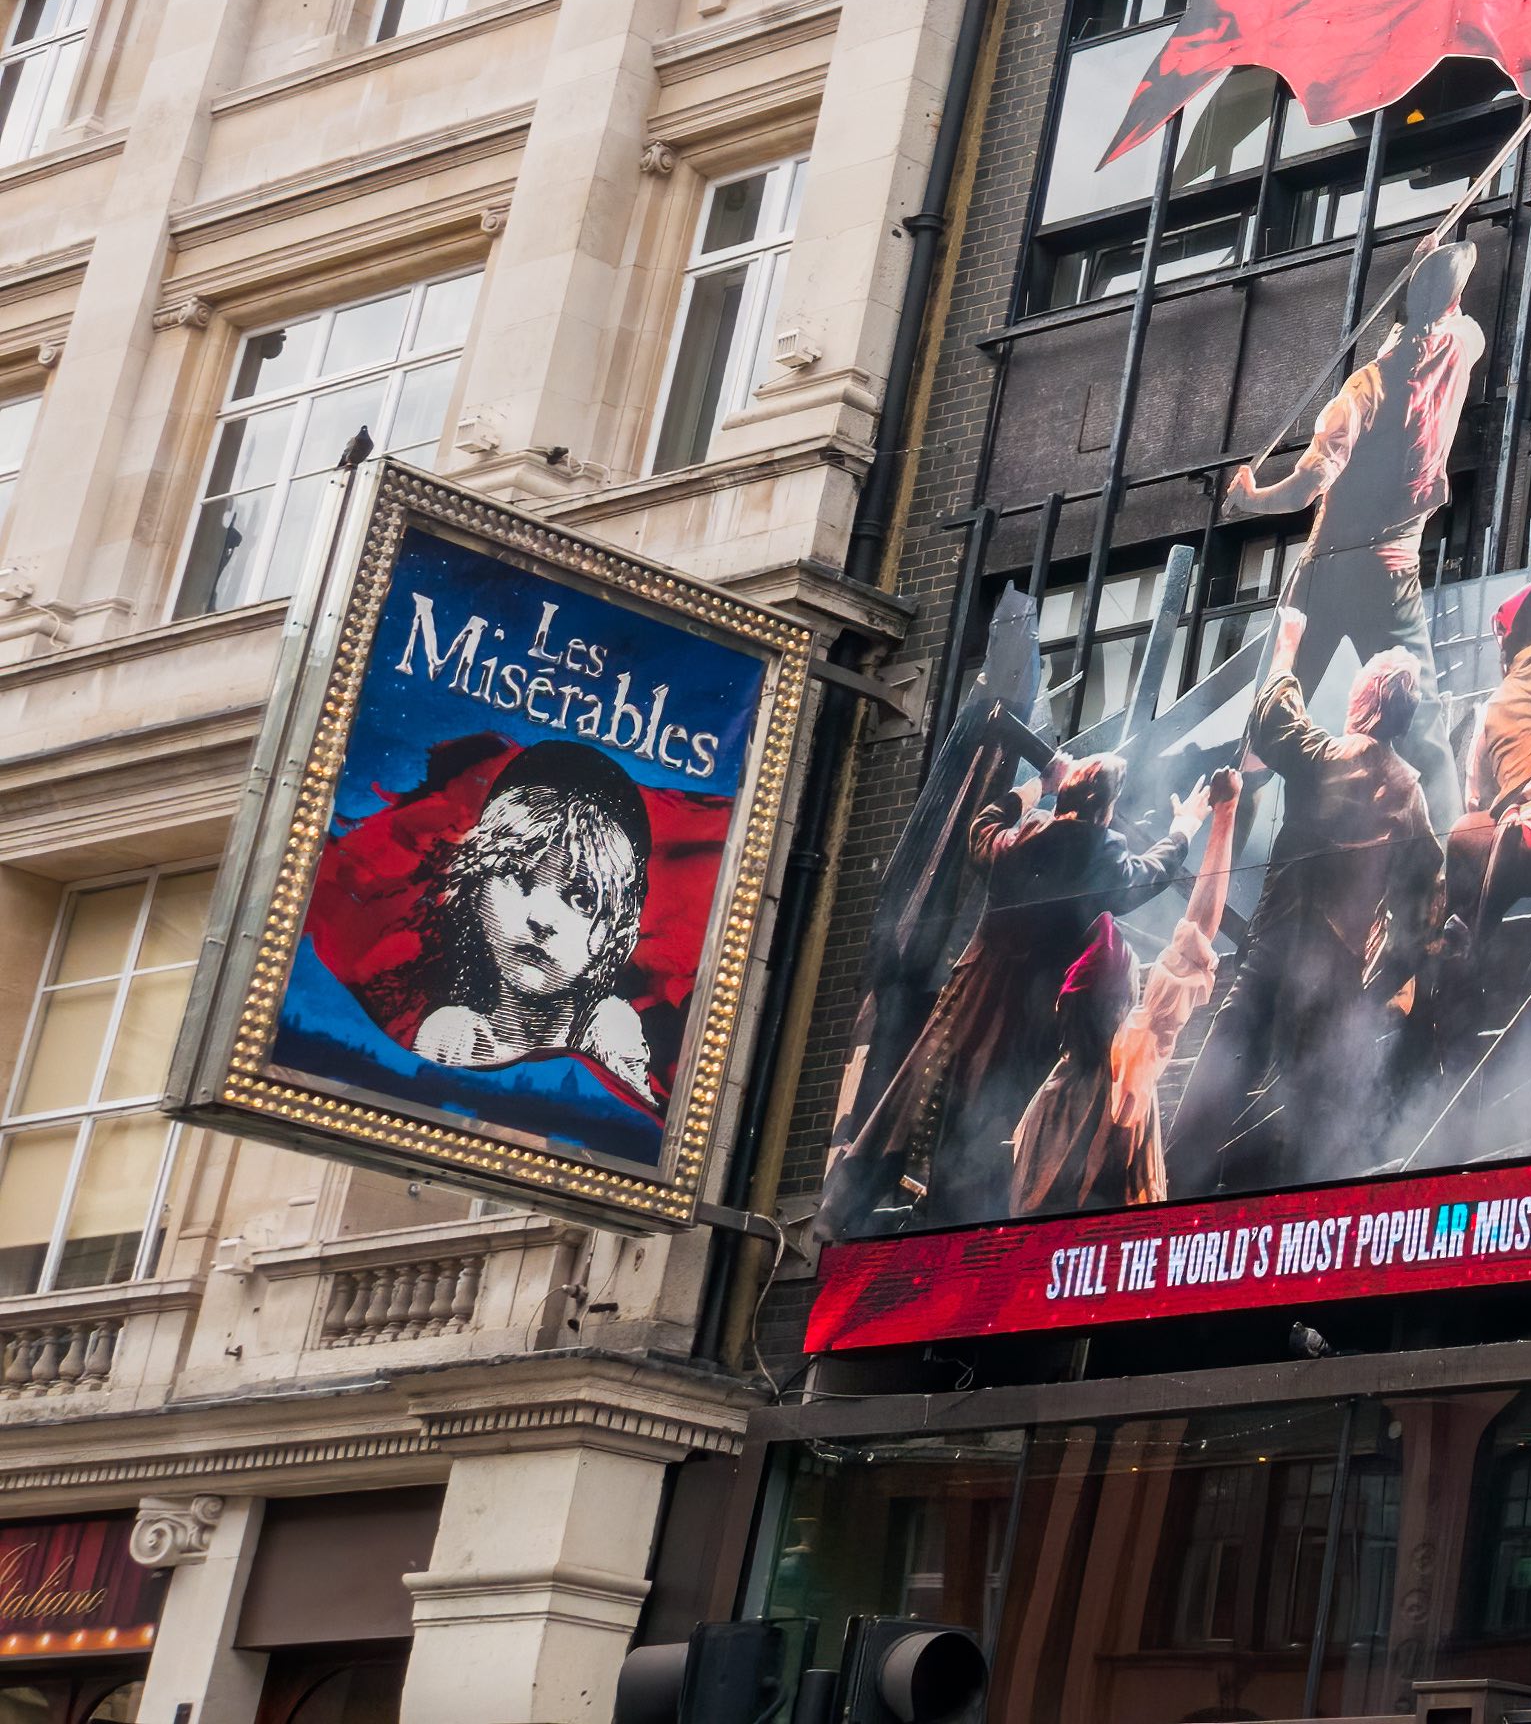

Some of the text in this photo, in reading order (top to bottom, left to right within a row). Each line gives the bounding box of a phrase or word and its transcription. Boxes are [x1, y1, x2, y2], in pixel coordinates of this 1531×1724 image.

[394, 592, 720, 779] Misérables
[527, 601, 608, 678] Les
[1045, 1247, 1107, 1301] STILL
[1116, 1238, 1157, 1293] THE
[1166, 1226, 1271, 1289] WORLD'S
[1276, 1216, 1351, 1277] MOST
[1352, 1202, 1469, 1268] POPULAR
